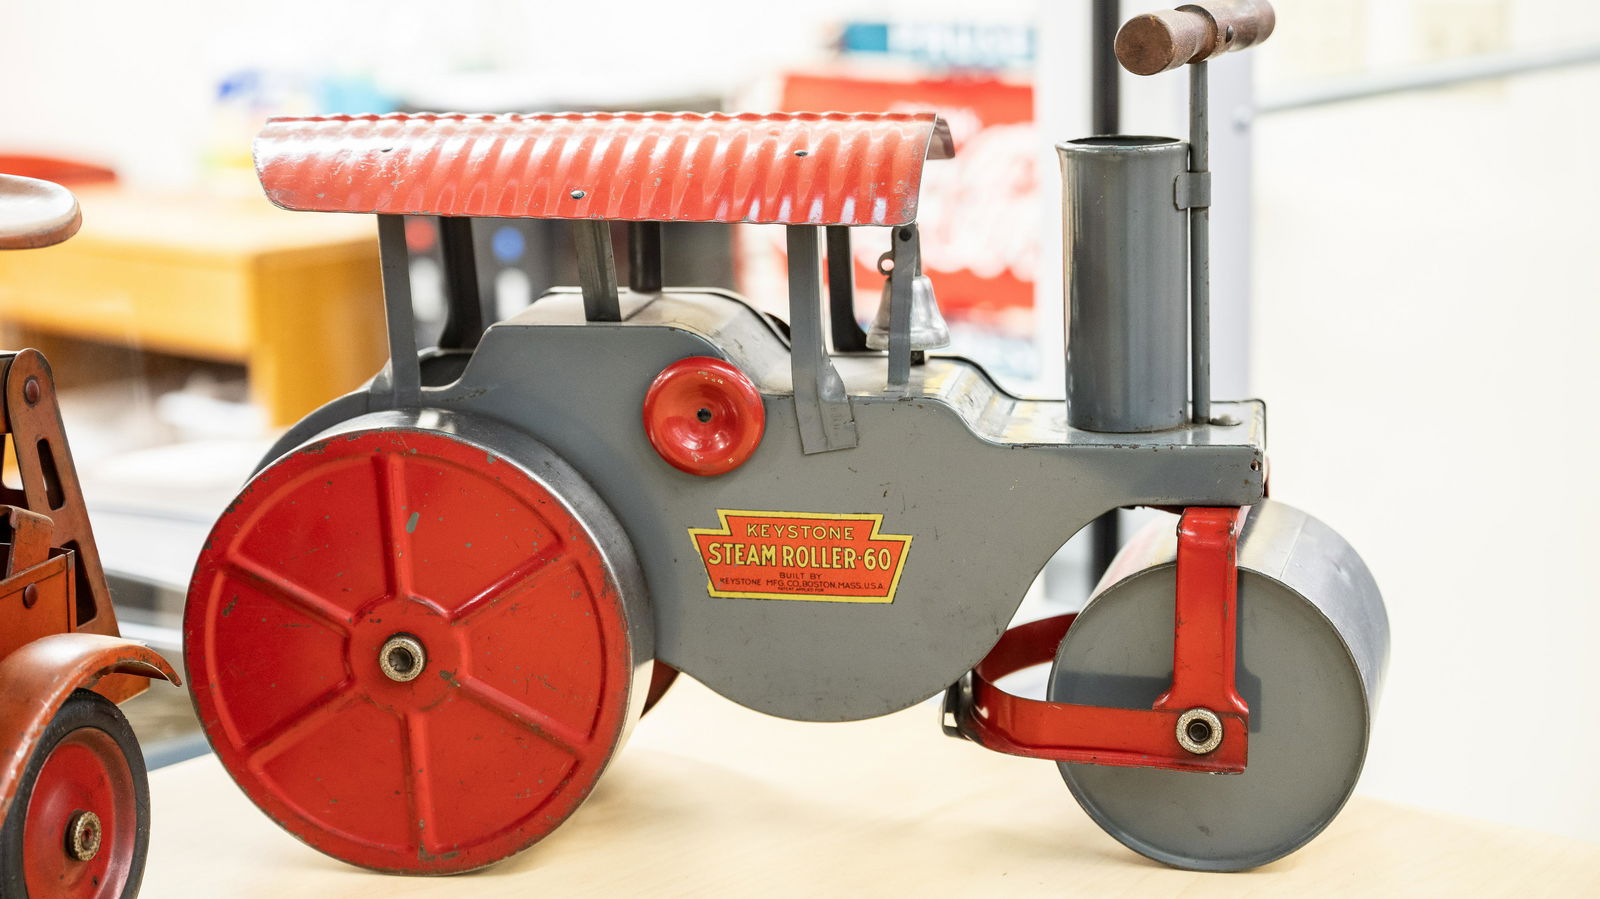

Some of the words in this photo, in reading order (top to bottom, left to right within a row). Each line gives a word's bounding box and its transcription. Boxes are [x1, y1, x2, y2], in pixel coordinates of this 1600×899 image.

[746, 523, 855, 540] KEYSTONE
[707, 542, 777, 567] STEAM
[719, 577, 761, 586] KEYSTONE
